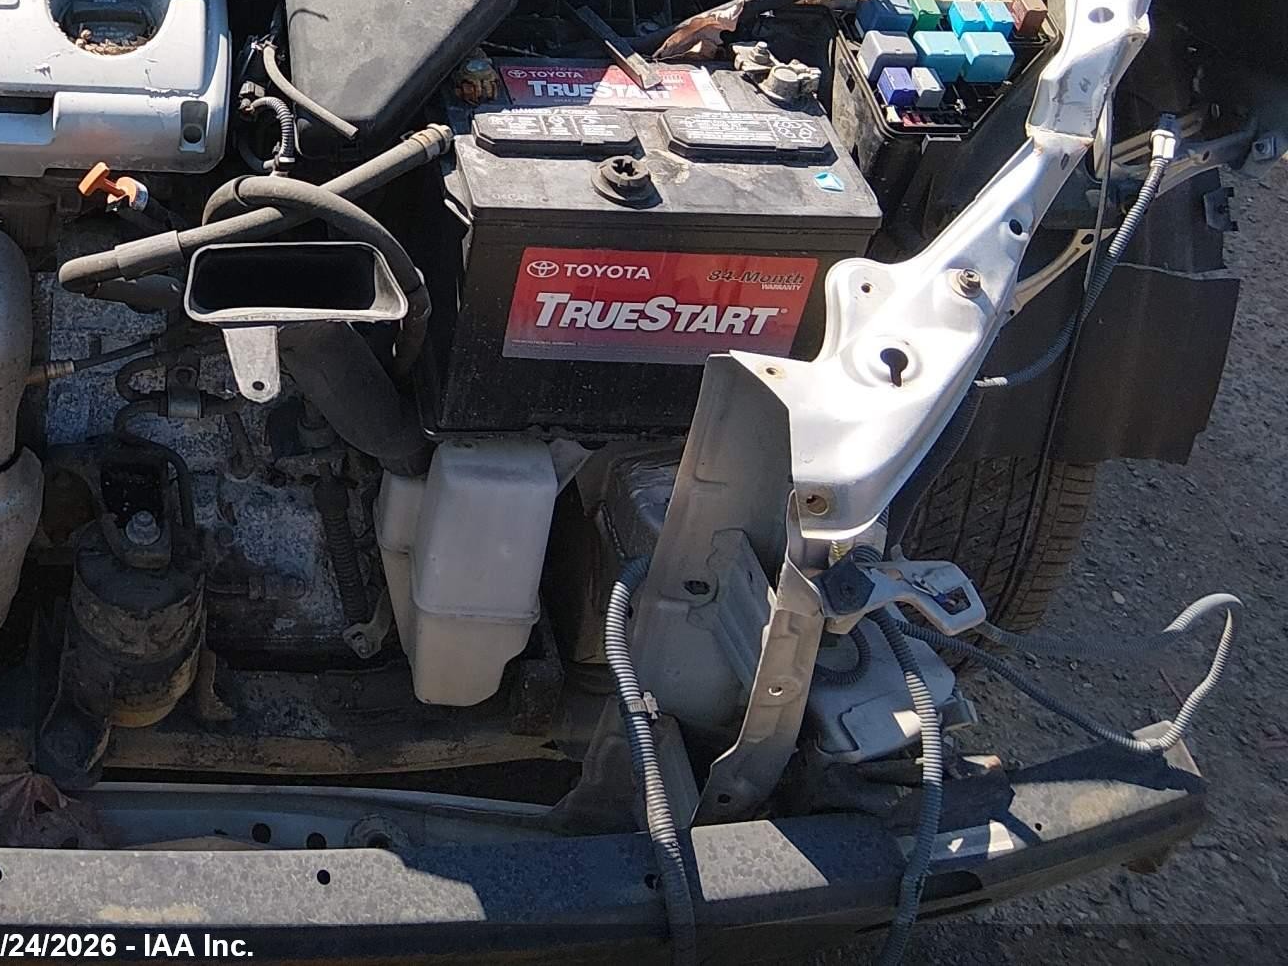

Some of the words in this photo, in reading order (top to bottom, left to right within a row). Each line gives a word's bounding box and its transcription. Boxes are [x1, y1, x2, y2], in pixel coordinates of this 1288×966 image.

[528, 70, 584, 79] TOYOTA
[564, 263, 651, 281] TOYOTA
[707, 268, 805, 284] 84-Month
[761, 283, 802, 291] WARRANTY
